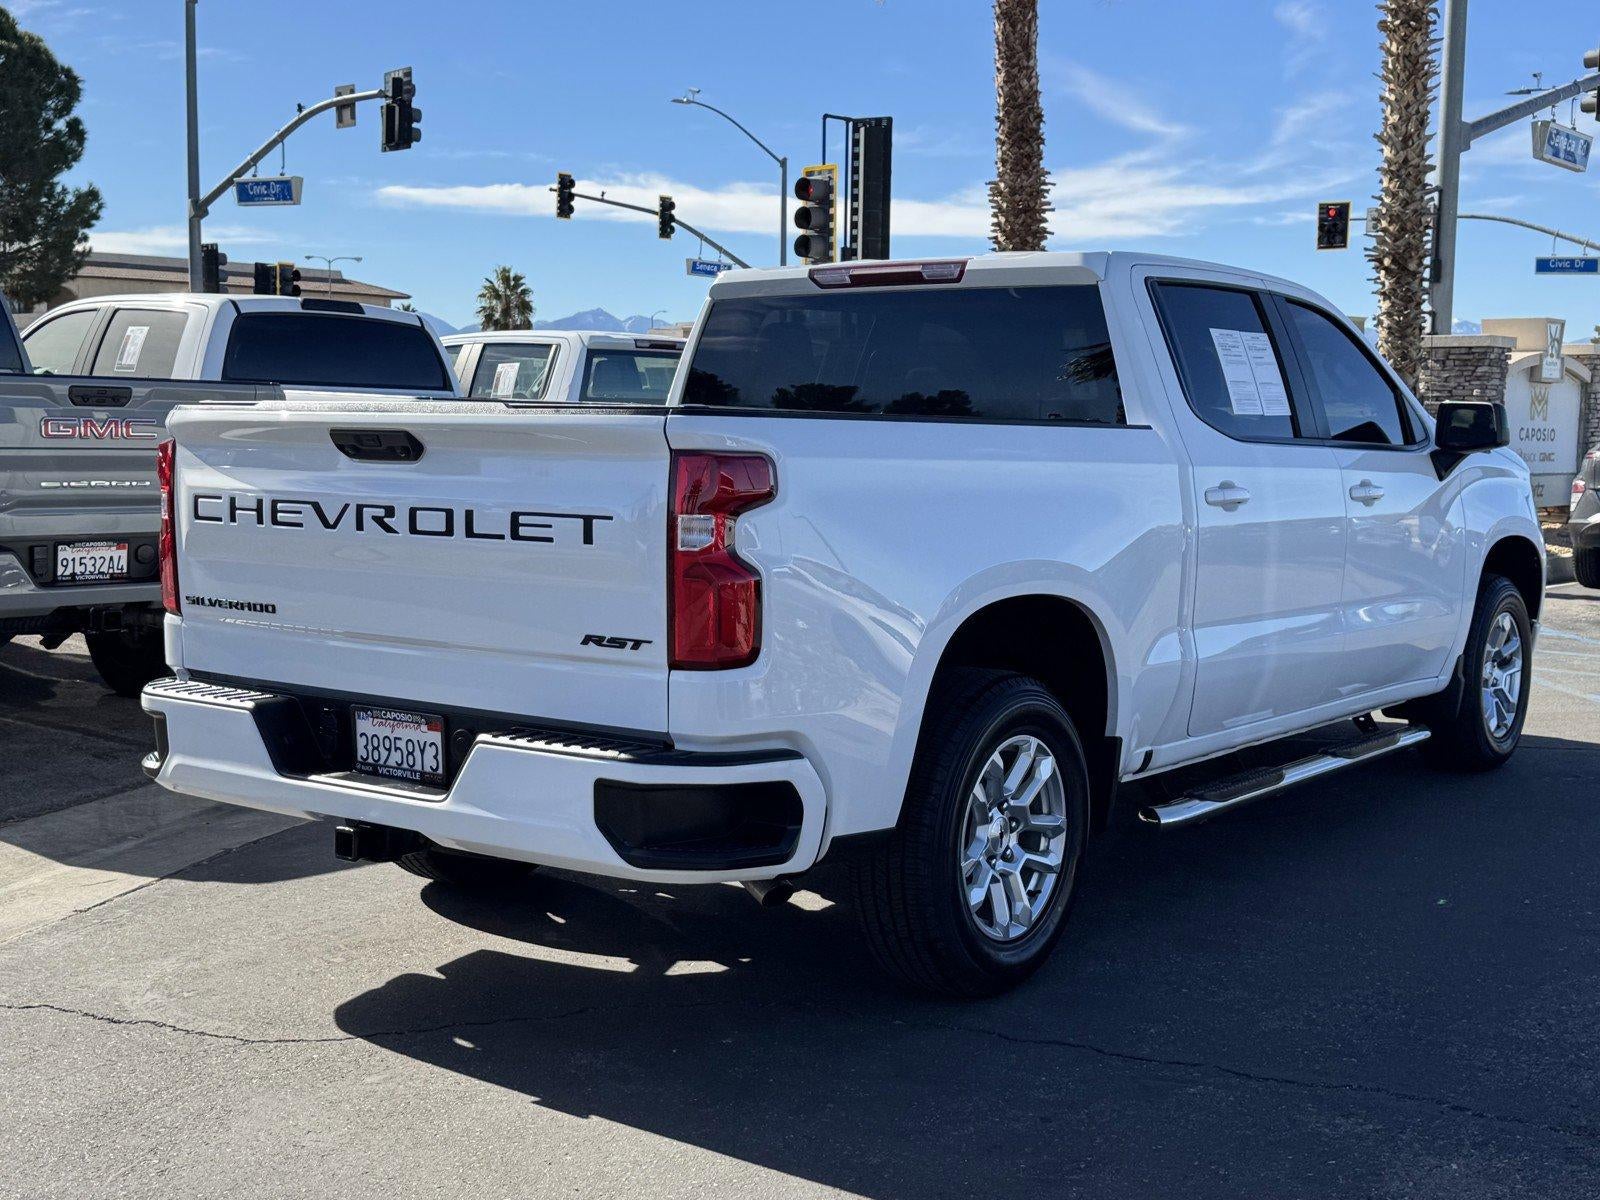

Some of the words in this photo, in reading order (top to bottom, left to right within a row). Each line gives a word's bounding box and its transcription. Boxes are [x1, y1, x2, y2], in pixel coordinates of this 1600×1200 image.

[1550, 130, 1576, 152] Seneca
[247, 182, 268, 195] Civic
[269, 181, 281, 194] Dr
[696, 262, 718, 272] Seneca
[1549, 259, 1571, 268] Civic
[1574, 259, 1586, 268] Dr
[41, 417, 158, 439] GMC
[1518, 427, 1556, 442] CAPOSIO
[193, 494, 614, 545] CHEVROLET
[60, 555, 124, 577] 91532A4
[185, 595, 277, 614] SILVERADO
[580, 634, 654, 651] RST
[381, 710, 413, 722] CAPOSIO
[371, 718, 423, 734] California
[359, 732, 440, 772] 38958Y3
[377, 766, 421, 780] VICTORVILLE
